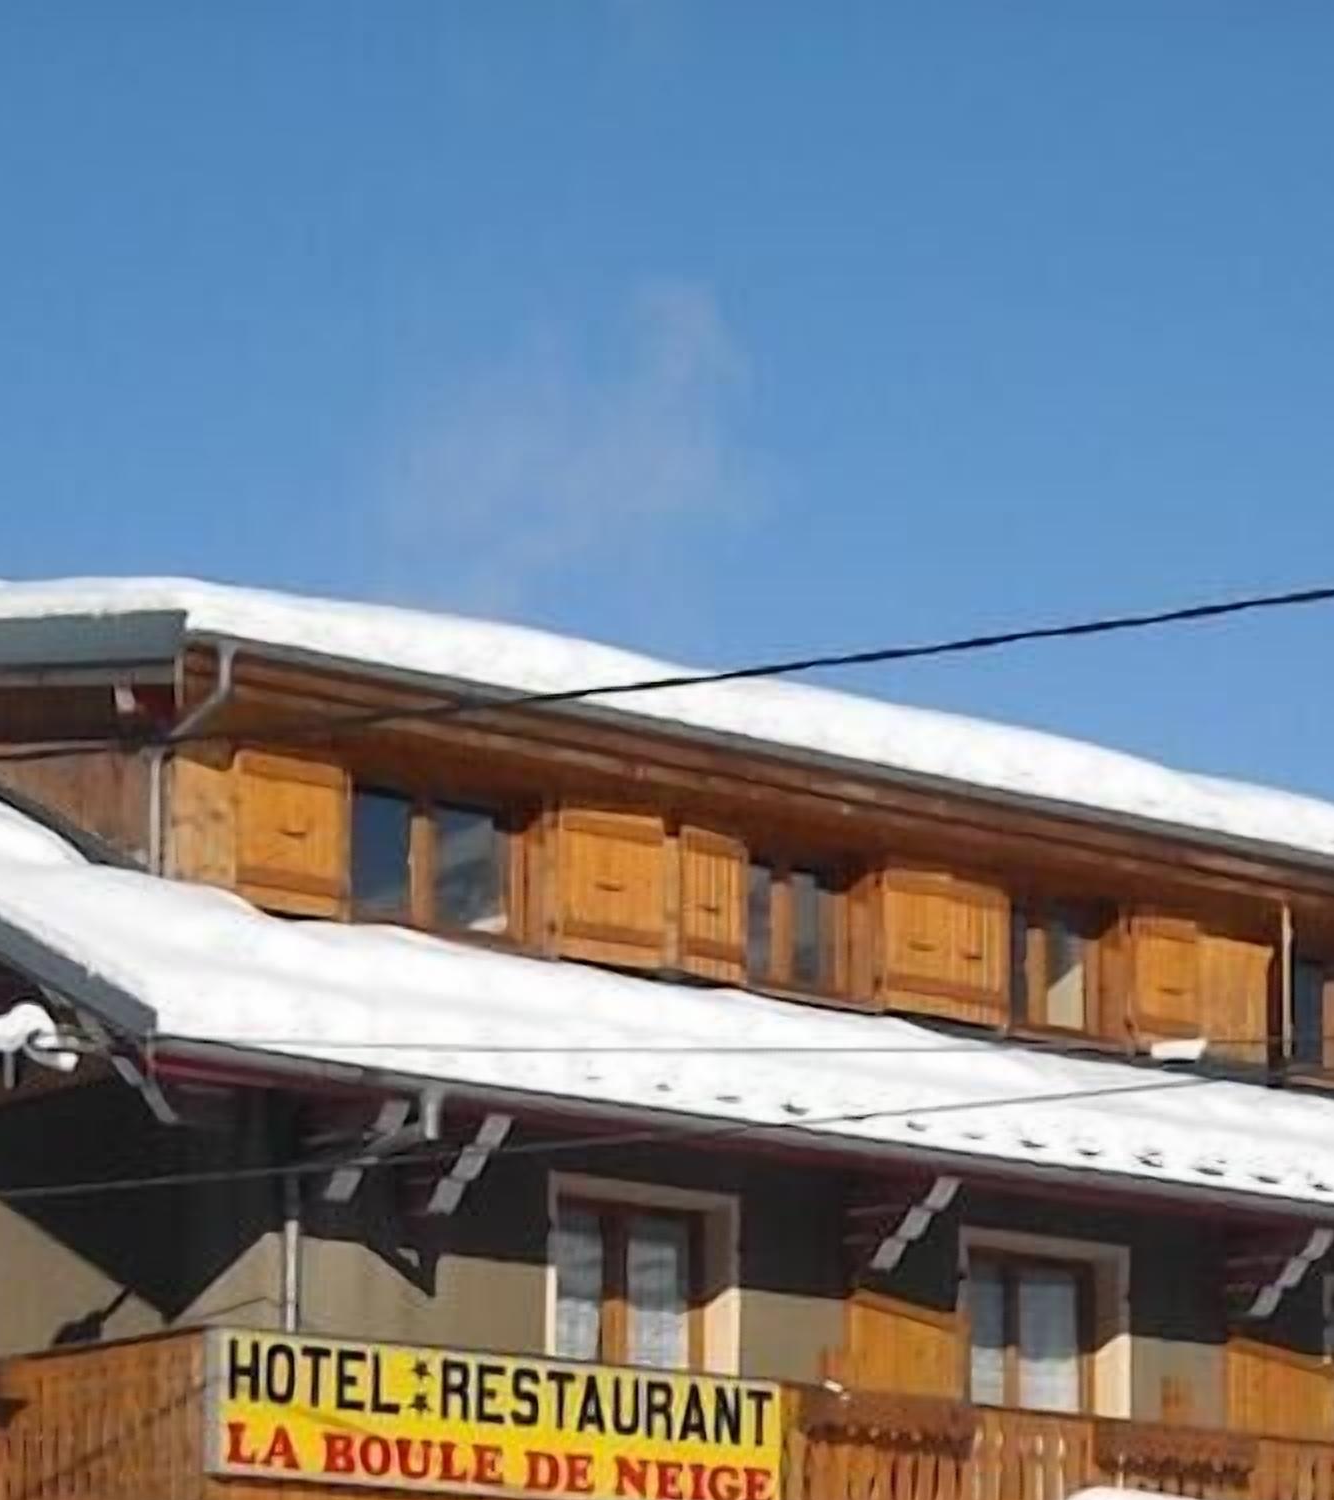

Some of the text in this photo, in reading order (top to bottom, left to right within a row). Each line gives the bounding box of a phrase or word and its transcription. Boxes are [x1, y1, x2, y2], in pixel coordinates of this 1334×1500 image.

[228, 1338, 773, 1446] HOTEL RESTAURANT
[227, 1422, 300, 1470] LA
[323, 1432, 504, 1485] BOULE
[524, 1450, 595, 1492] DE
